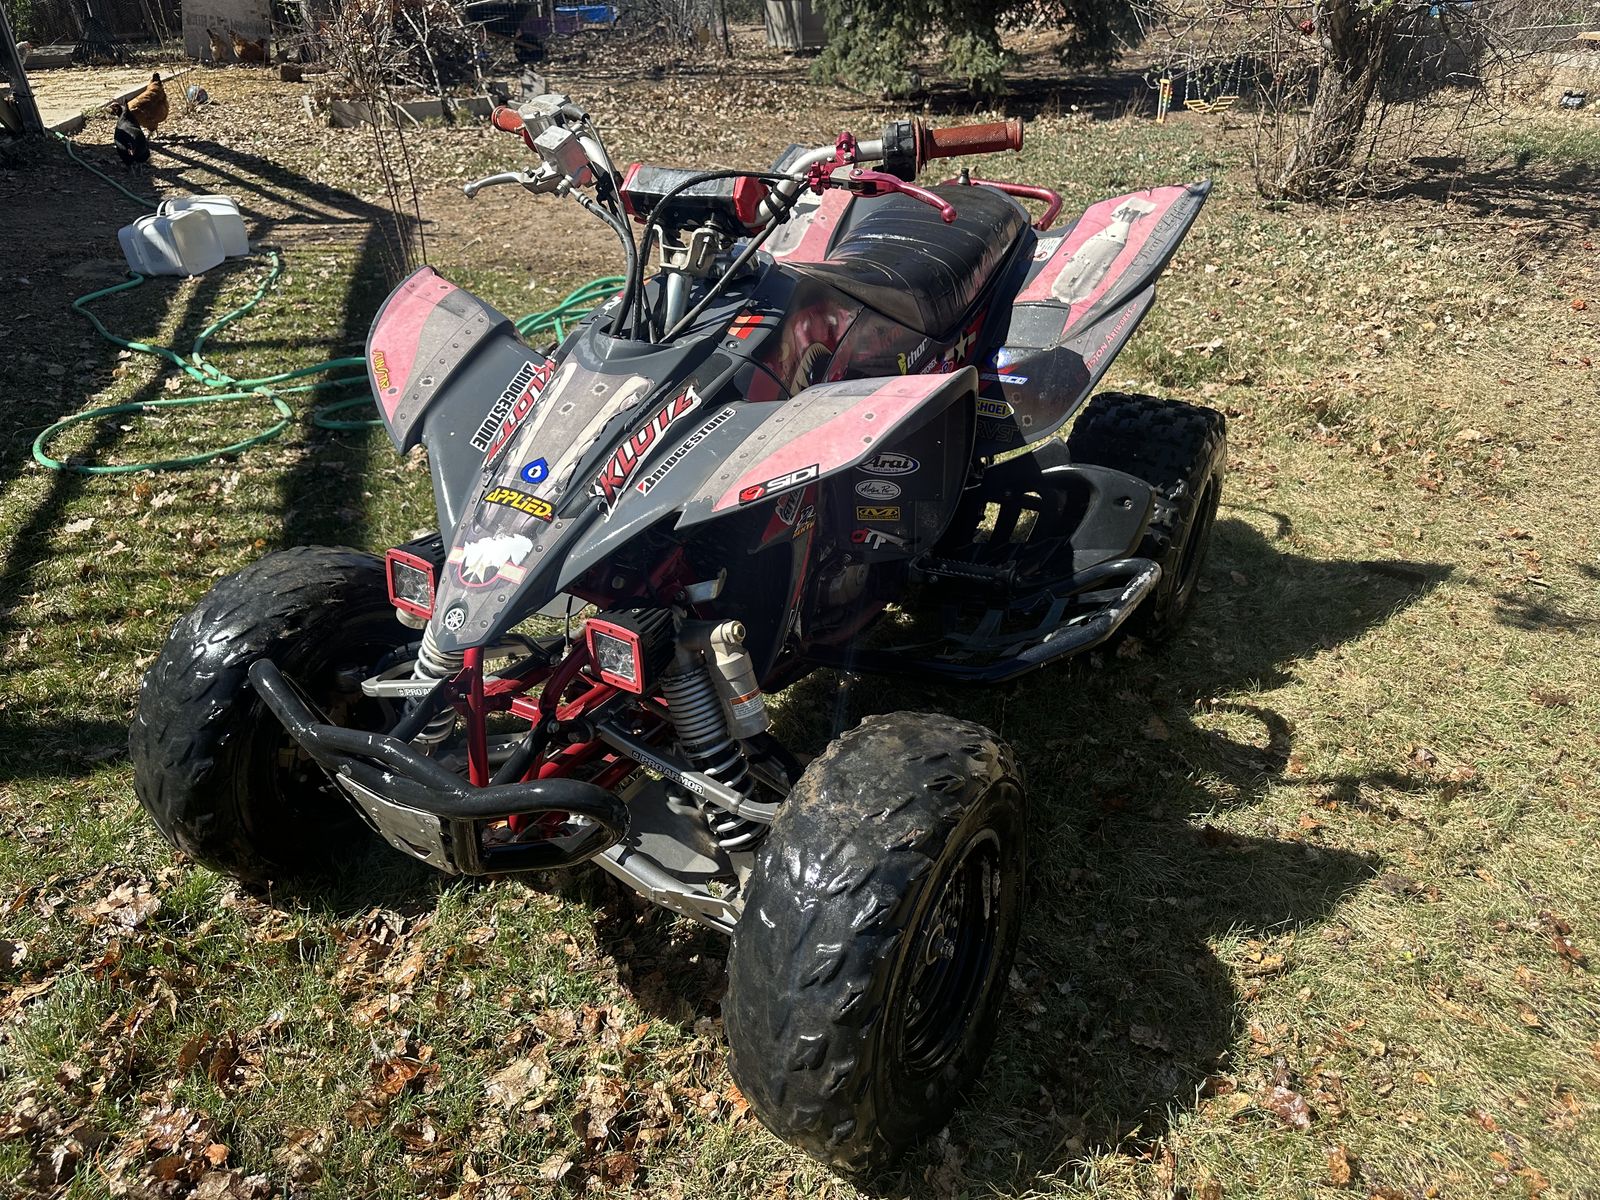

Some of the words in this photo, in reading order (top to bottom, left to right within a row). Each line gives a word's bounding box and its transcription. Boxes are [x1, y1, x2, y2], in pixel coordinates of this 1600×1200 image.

[907, 338, 928, 368] thor
[472, 362, 540, 451] BRIDGESTONE
[637, 408, 734, 495] BRIDGESTONE
[861, 455, 909, 468] Arai
[484, 487, 554, 517] APPLIED
[641, 754, 664, 772] PRO
[663, 768, 704, 795] ARMOR
